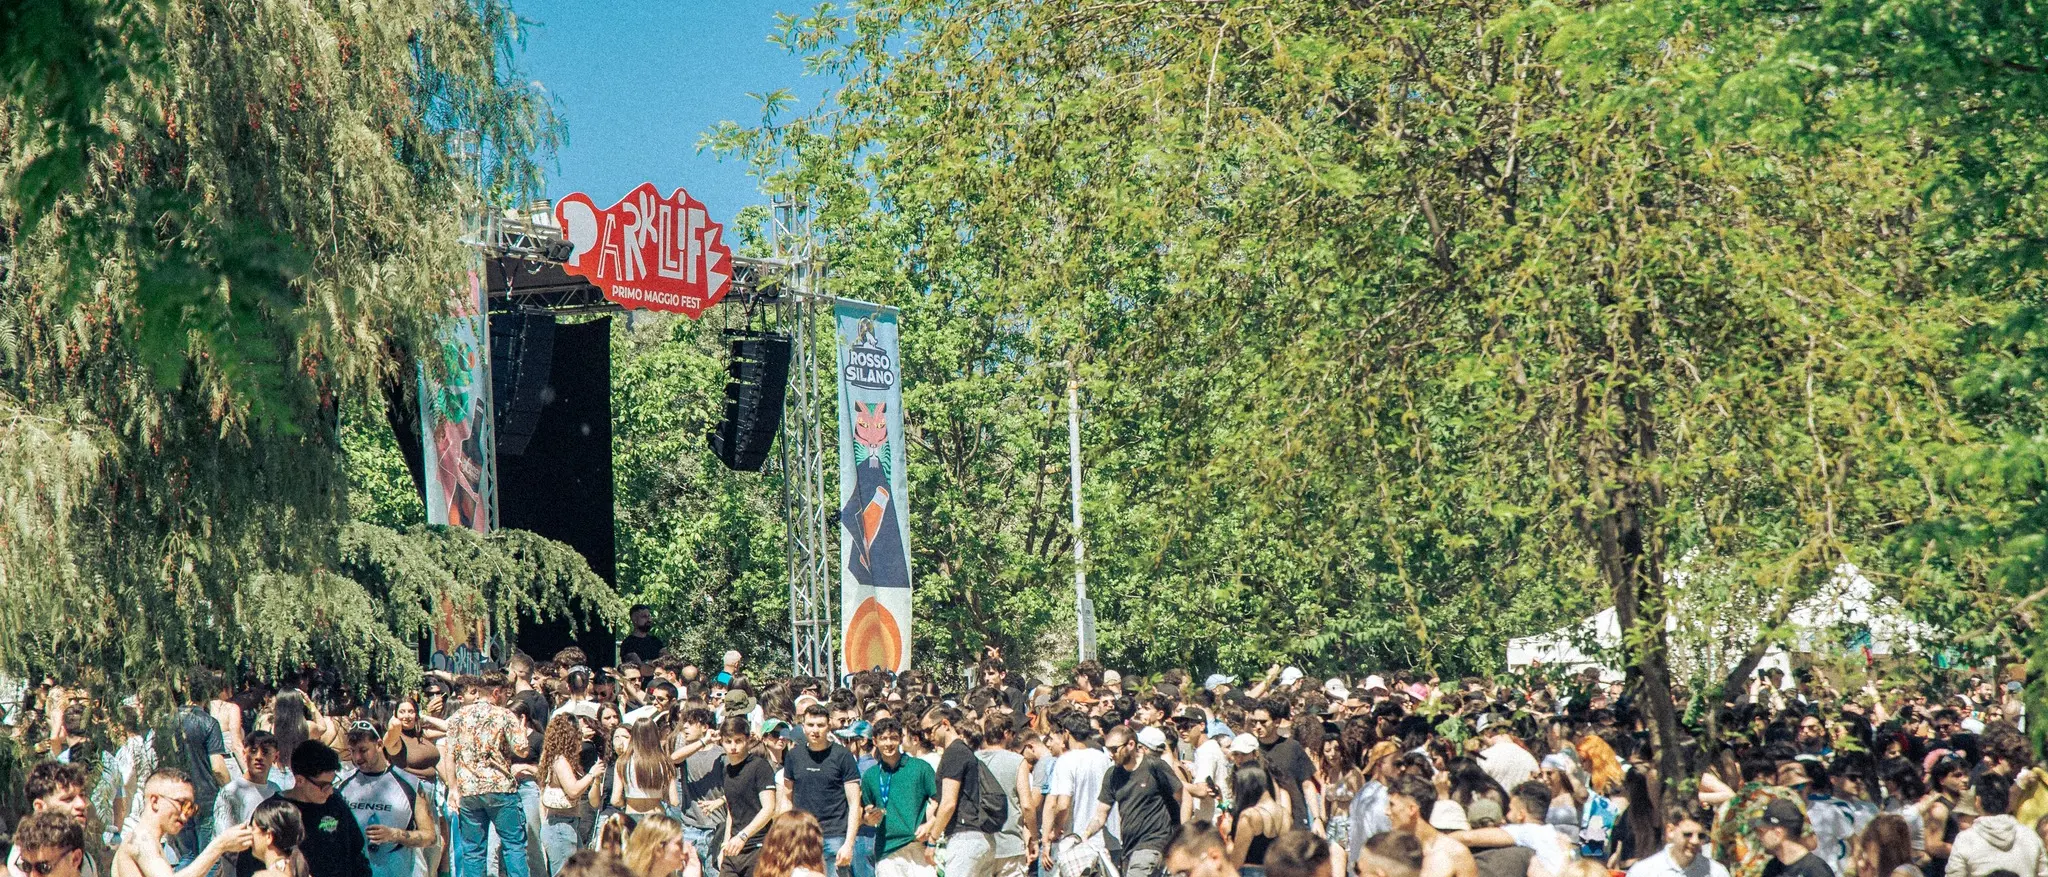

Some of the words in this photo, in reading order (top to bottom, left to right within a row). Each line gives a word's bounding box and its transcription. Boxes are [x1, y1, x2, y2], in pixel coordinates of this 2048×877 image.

[563, 191, 729, 299] PARKLIFE
[612, 285, 642, 300] PRIMO
[644, 290, 679, 306] MAGGIO
[681, 296, 701, 309] FEST
[850, 351, 890, 370] ROSSO
[845, 366, 894, 385] SILANO
